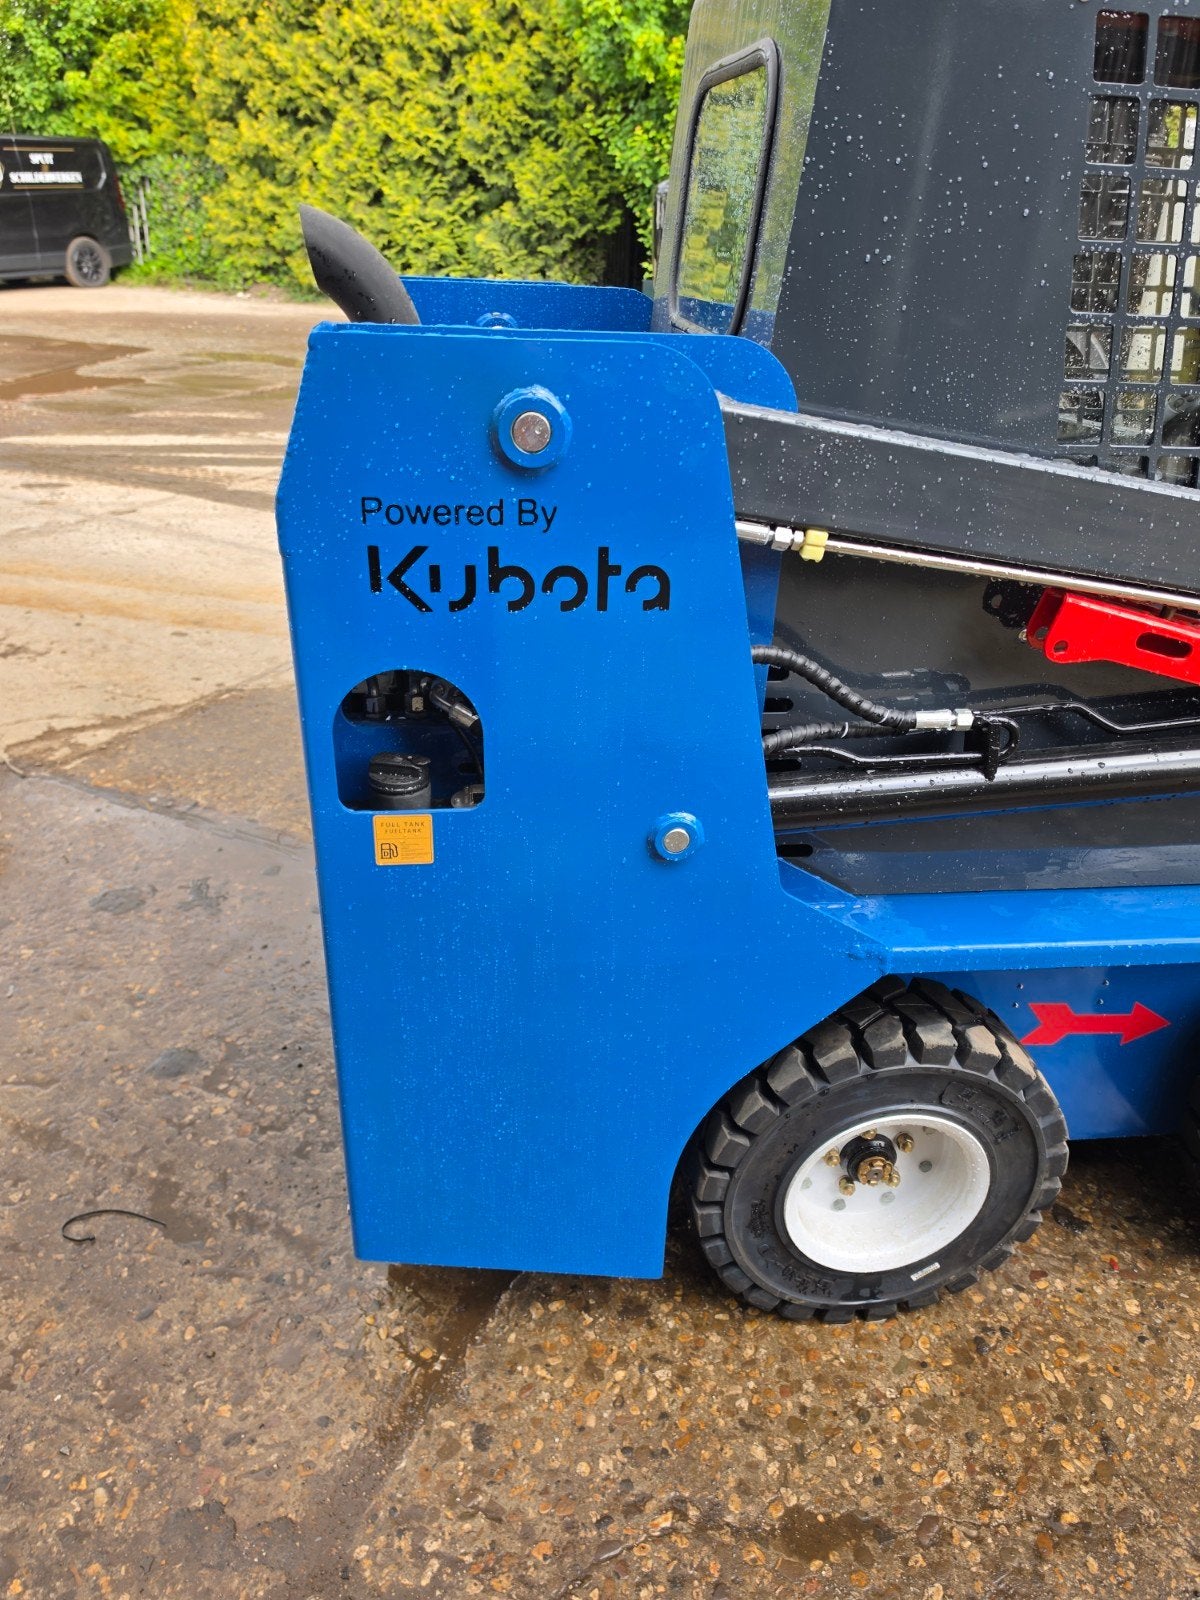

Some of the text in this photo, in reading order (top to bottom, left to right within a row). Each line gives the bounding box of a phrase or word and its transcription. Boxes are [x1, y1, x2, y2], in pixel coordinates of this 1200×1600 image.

[361, 496, 558, 533] Powered By
[367, 545, 671, 613] Kubota
